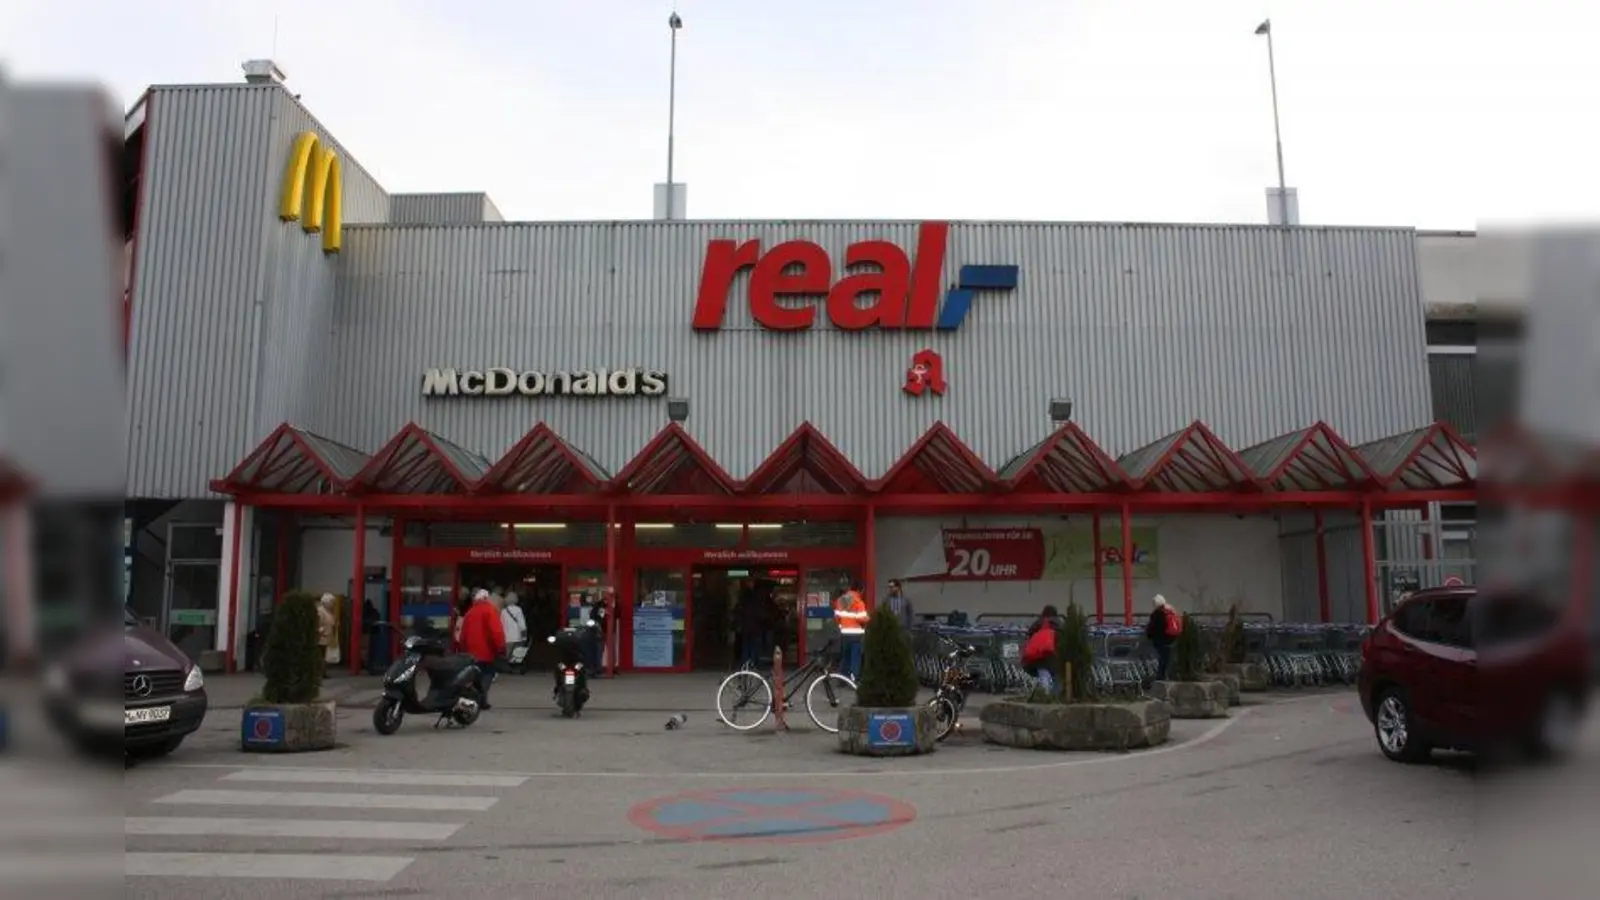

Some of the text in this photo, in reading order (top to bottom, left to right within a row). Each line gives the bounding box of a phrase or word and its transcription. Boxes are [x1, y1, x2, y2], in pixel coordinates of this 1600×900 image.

[422, 367, 667, 396] McDonald's
[951, 547, 1018, 577] 20 UHR
